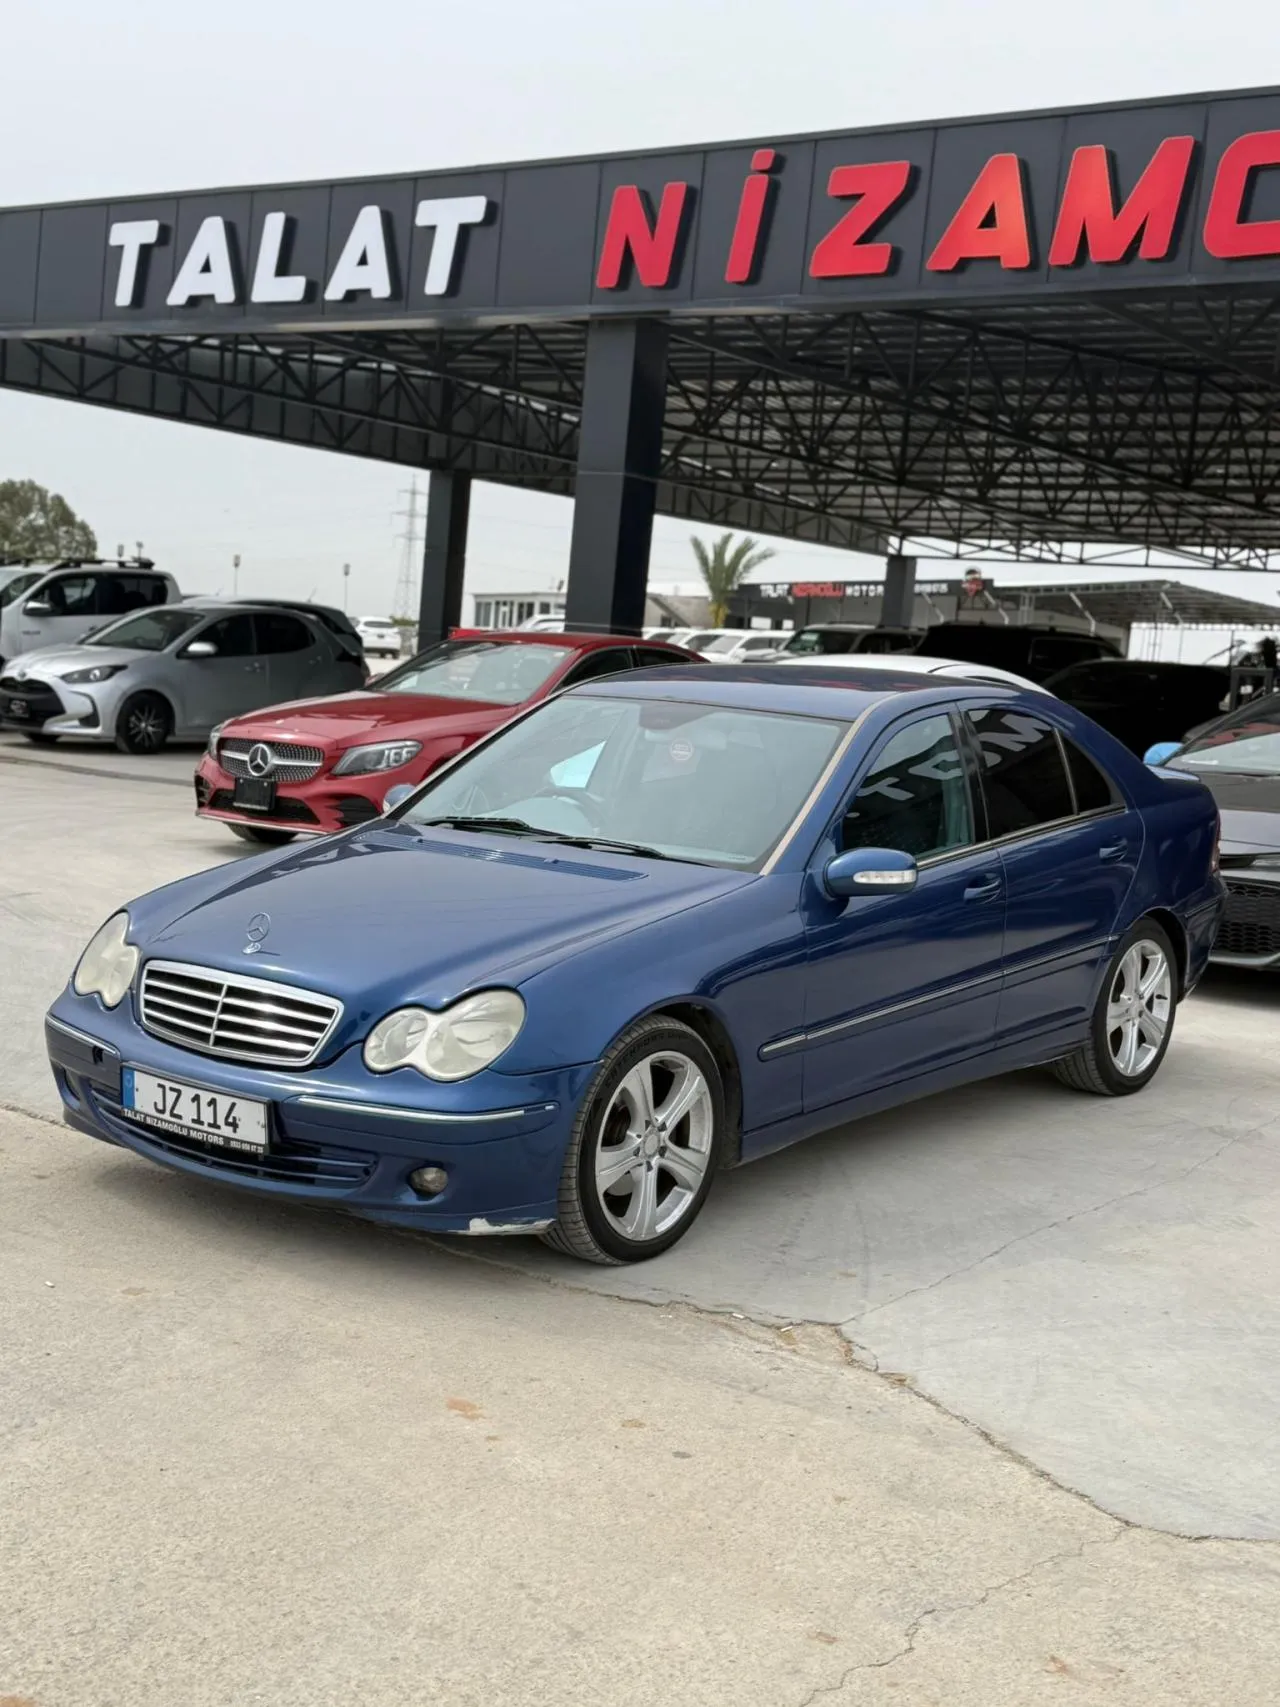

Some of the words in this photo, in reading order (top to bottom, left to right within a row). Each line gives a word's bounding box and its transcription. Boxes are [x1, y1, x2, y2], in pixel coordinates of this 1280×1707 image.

[109, 195, 486, 306] TALAT
[124, 1109, 145, 1122] TALAT
[190, 1130, 224, 1145] MOTORS
[153, 1082, 184, 1121] JZ
[190, 1093, 240, 1134] 114
